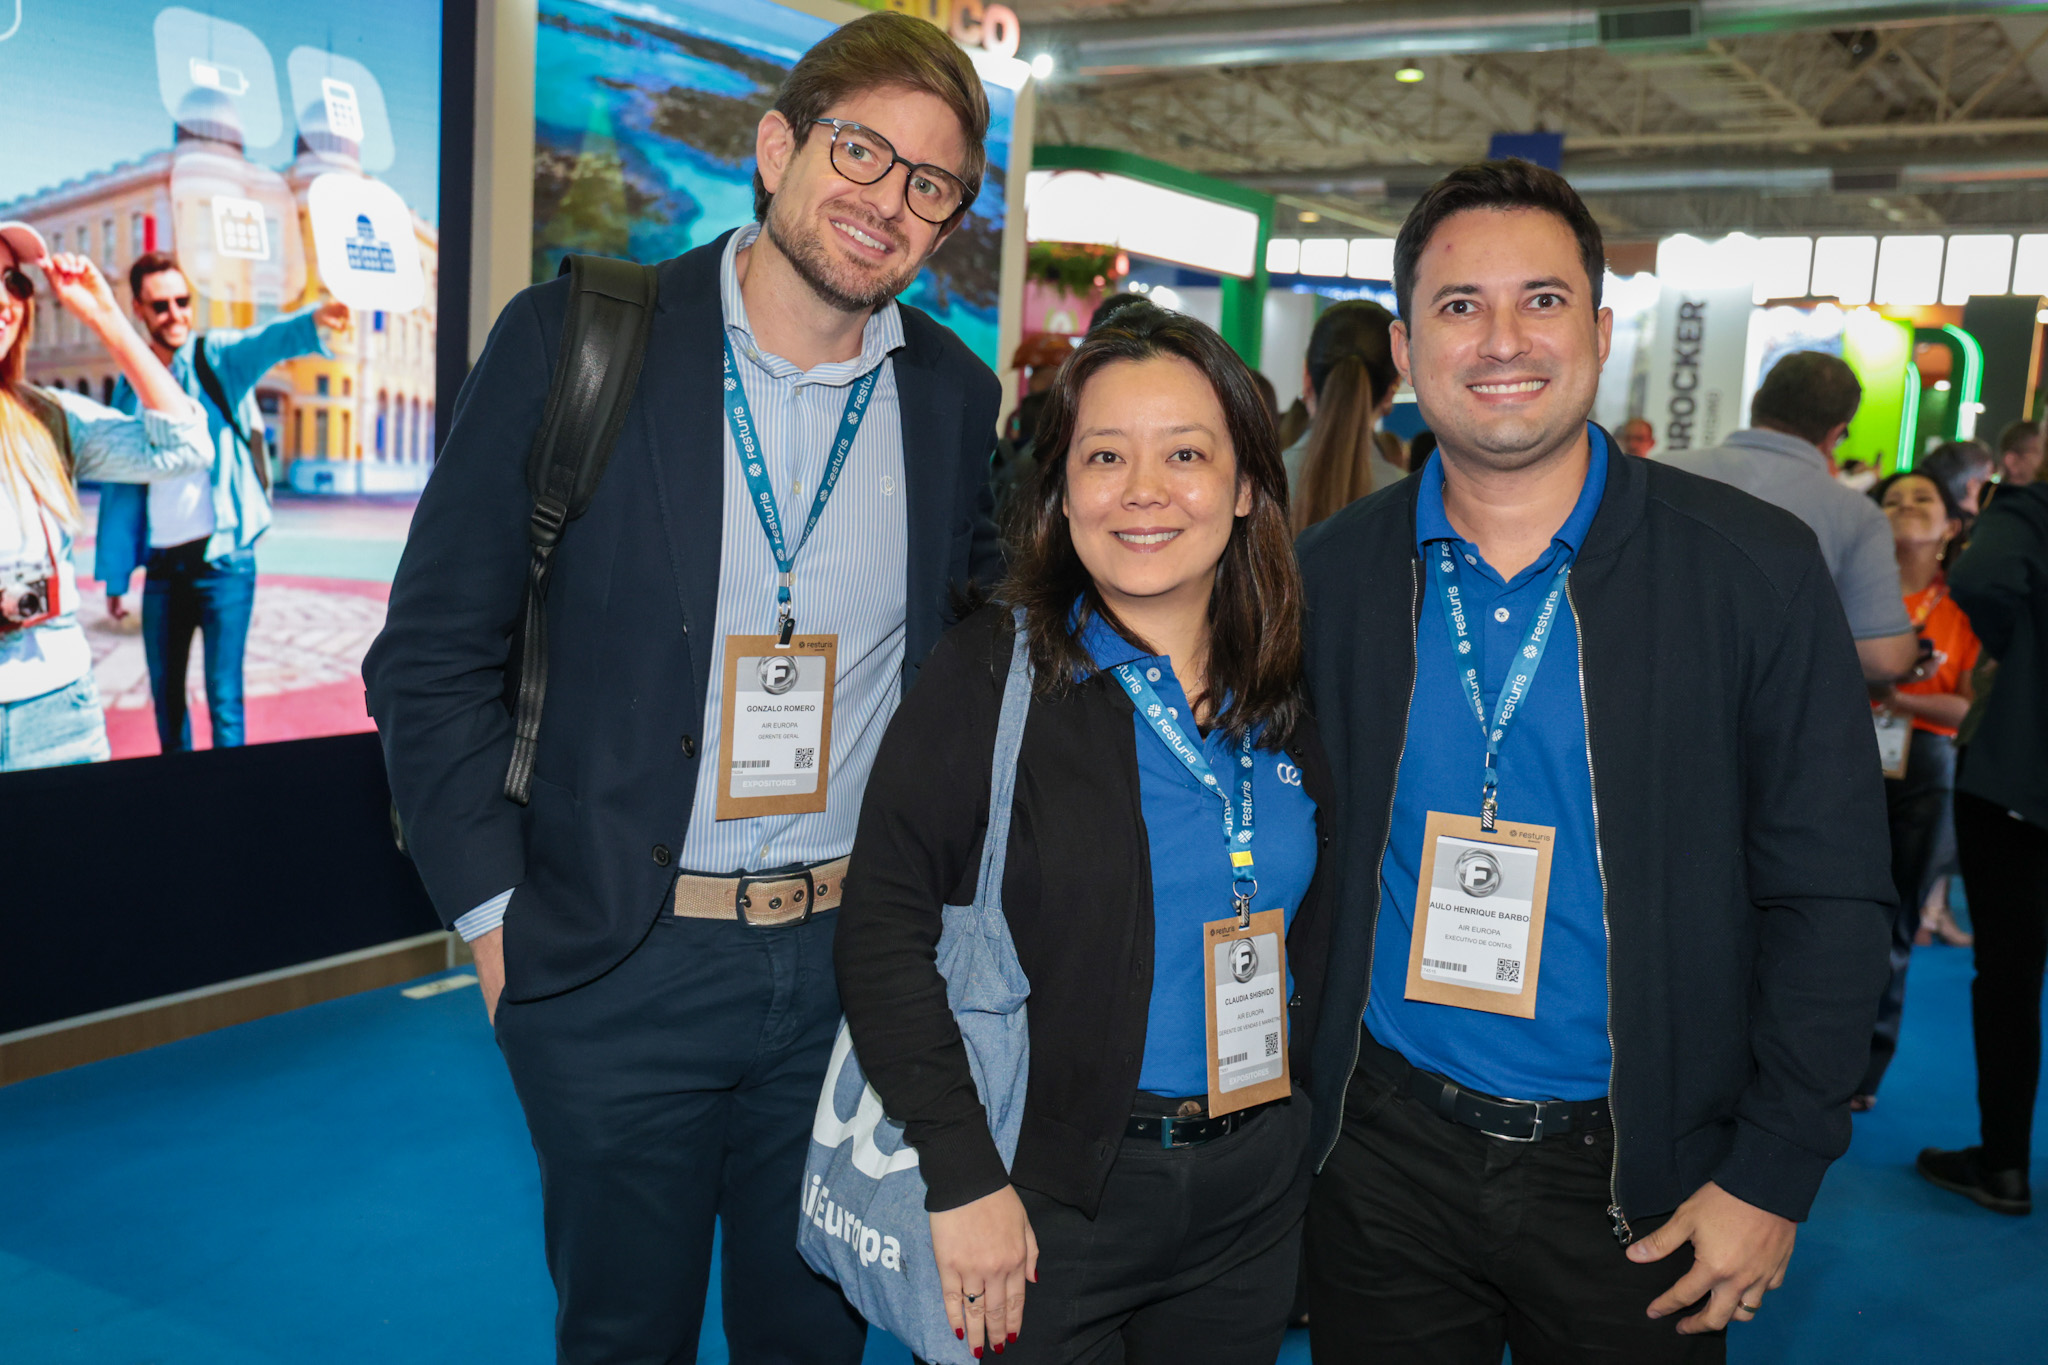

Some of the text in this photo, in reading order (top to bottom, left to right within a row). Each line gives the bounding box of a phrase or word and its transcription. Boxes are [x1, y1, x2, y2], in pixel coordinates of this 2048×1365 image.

[886, 0, 1020, 57] UCO
[733, 406, 757, 460] Festuris
[827, 438, 849, 488] Festuris
[760, 492, 782, 544] Festuris
[1447, 585, 1468, 637] Festuris
[1531, 590, 1558, 642] Festuris
[746, 704, 816, 713] GONZALO ROMERO
[1467, 668, 1485, 722] Festuris
[1499, 673, 1527, 726] Festuris
[1156, 718, 1196, 765] Festuris
[742, 778, 797, 788] EXPOSITORES
[1242, 781, 1253, 827] Festuris
[1519, 831, 1550, 842] Festuris
[1429, 901, 1532, 923] AULO HENRIQUE BARBO
[1444, 934, 1477, 944] EXECUTIVO
[1488, 940, 1512, 950] CONTAS
[1458, 924, 1501, 936] AIR EUROPA
[1225, 987, 1275, 1006] CLAUDIA SHISHIDO
[1245, 1009, 1265, 1018] EUROPA
[1218, 1027, 1237, 1037] GERENTE
[1243, 1021, 1259, 1030] VENDAS
[1229, 1068, 1270, 1086] EXPOSITORES
